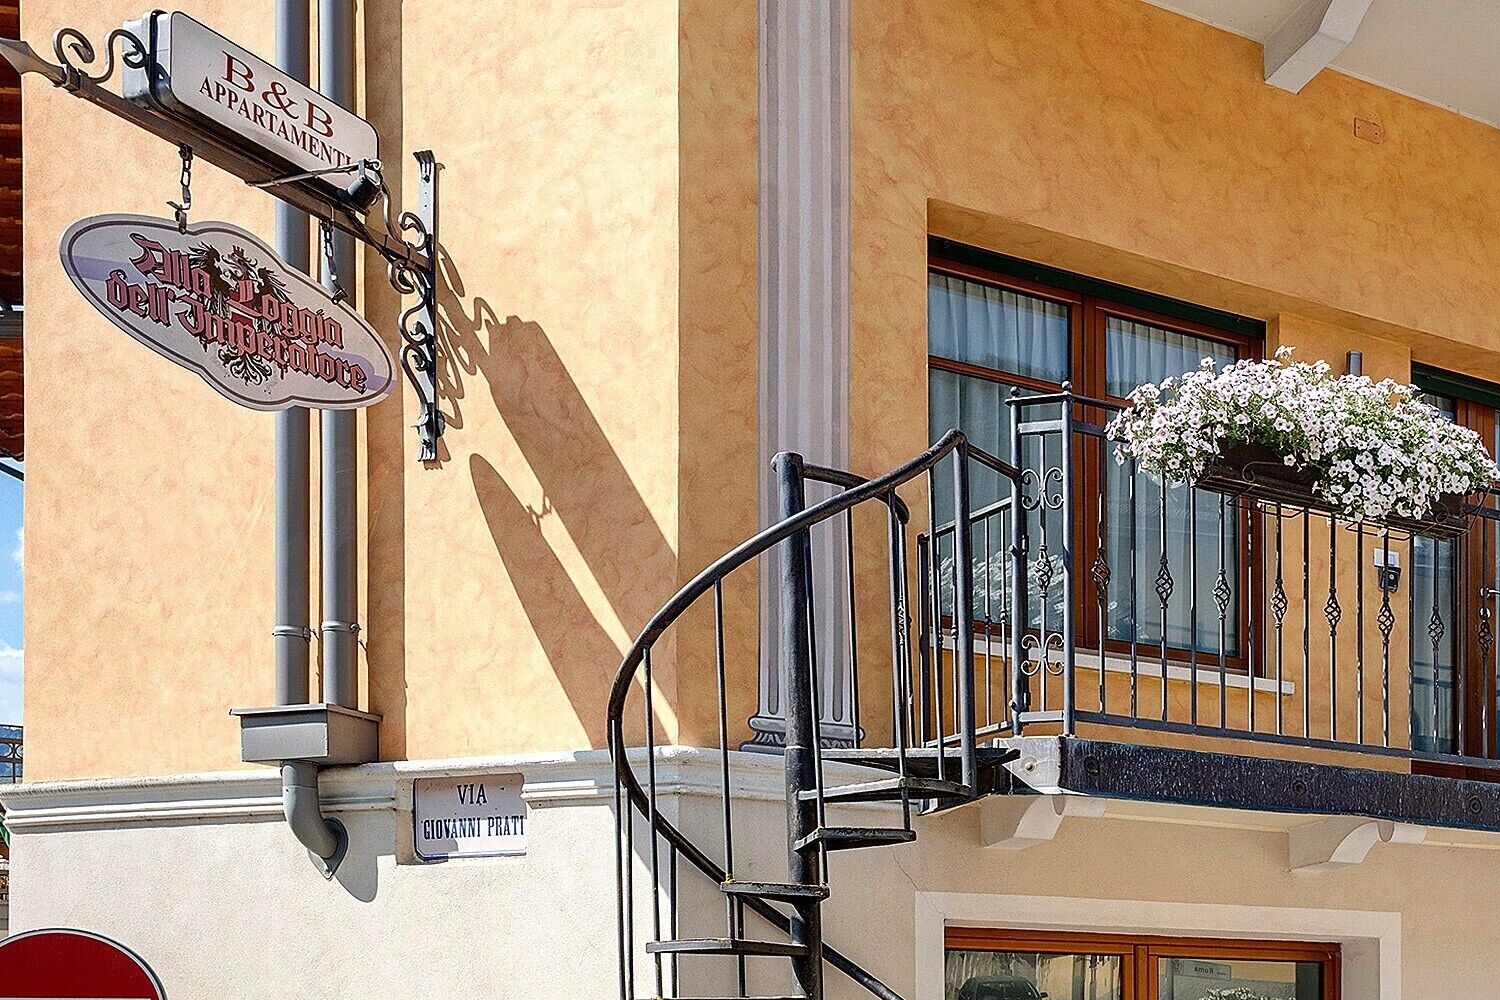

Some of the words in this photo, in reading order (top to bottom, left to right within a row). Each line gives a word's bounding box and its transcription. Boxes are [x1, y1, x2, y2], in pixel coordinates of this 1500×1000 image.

[129, 233, 213, 299] Alla
[229, 279, 345, 349] Loggia
[457, 783, 487, 805] VIA
[423, 818, 481, 839] GIOVANNI
[487, 815, 525, 837] PRATI
